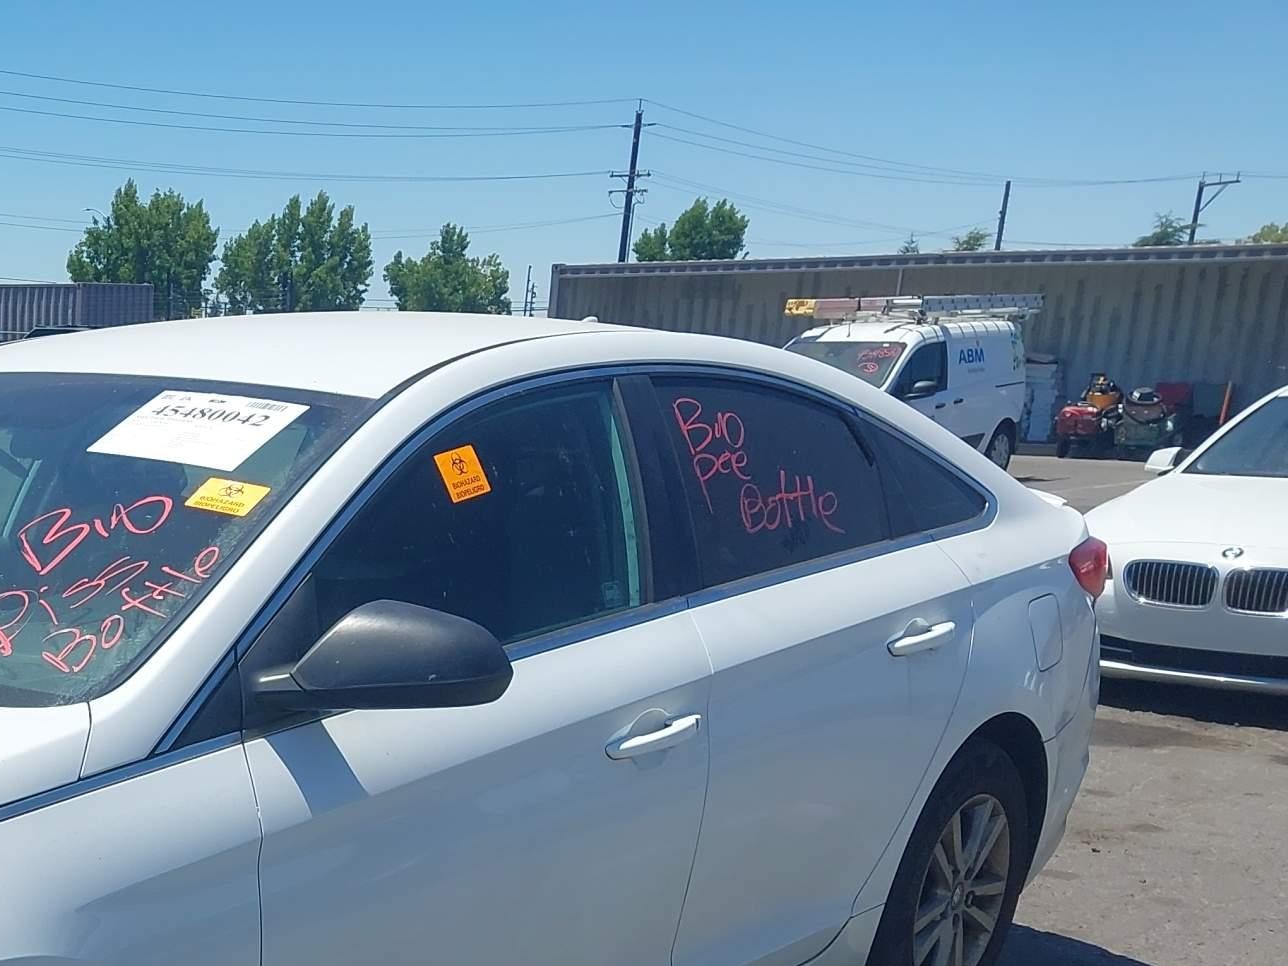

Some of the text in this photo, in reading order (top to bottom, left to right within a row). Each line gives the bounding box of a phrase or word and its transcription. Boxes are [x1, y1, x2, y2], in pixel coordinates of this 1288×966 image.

[958, 347, 985, 365] ABM
[151, 404, 271, 427] 45480042
[199, 495, 246, 508] BIOHAZARD
[740, 469, 846, 534] Bottle
